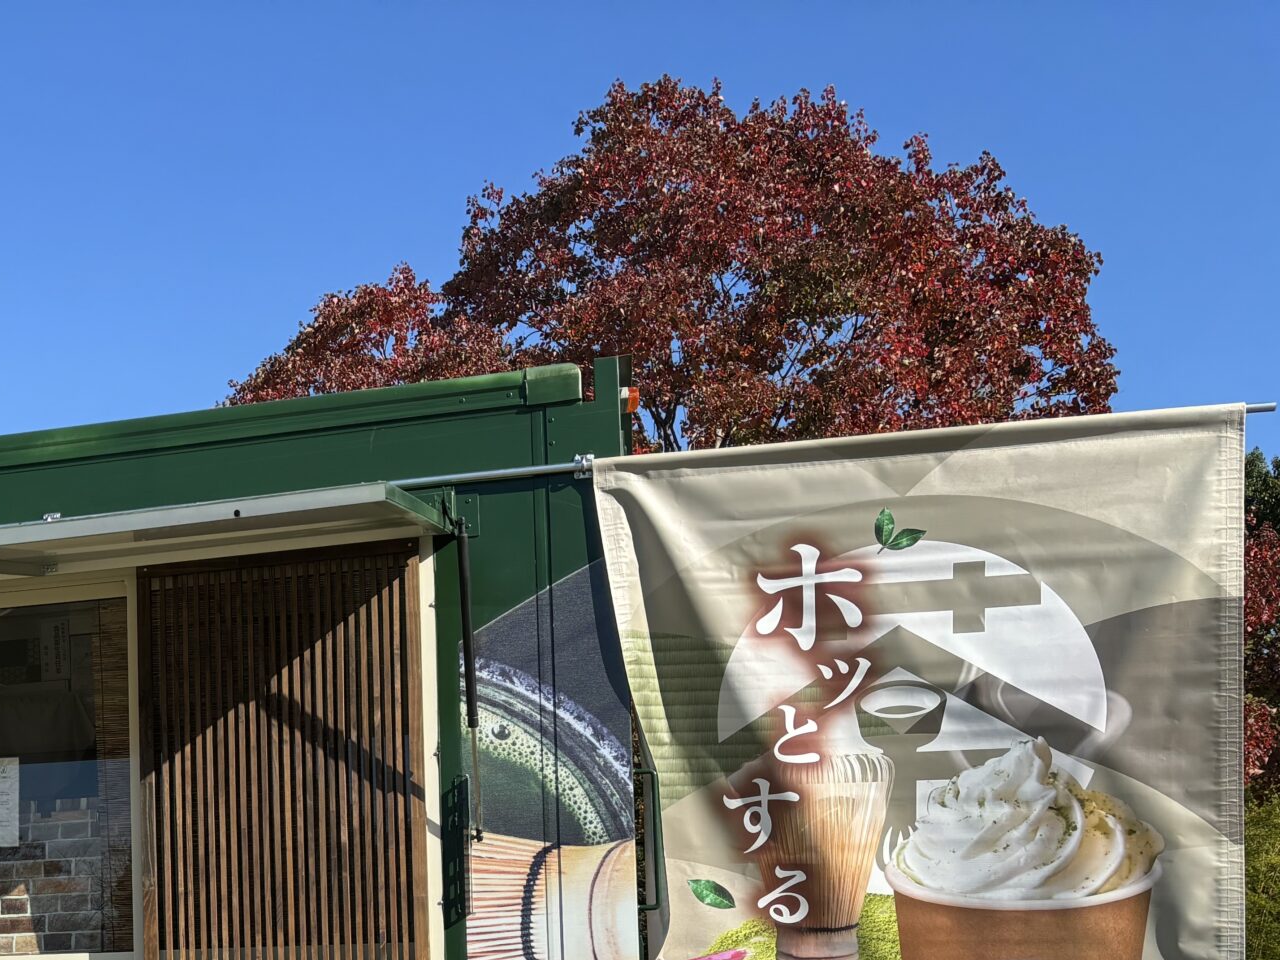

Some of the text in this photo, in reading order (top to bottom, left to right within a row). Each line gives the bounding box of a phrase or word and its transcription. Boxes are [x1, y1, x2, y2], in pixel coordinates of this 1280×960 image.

[722, 543, 871, 924] ホッとする
